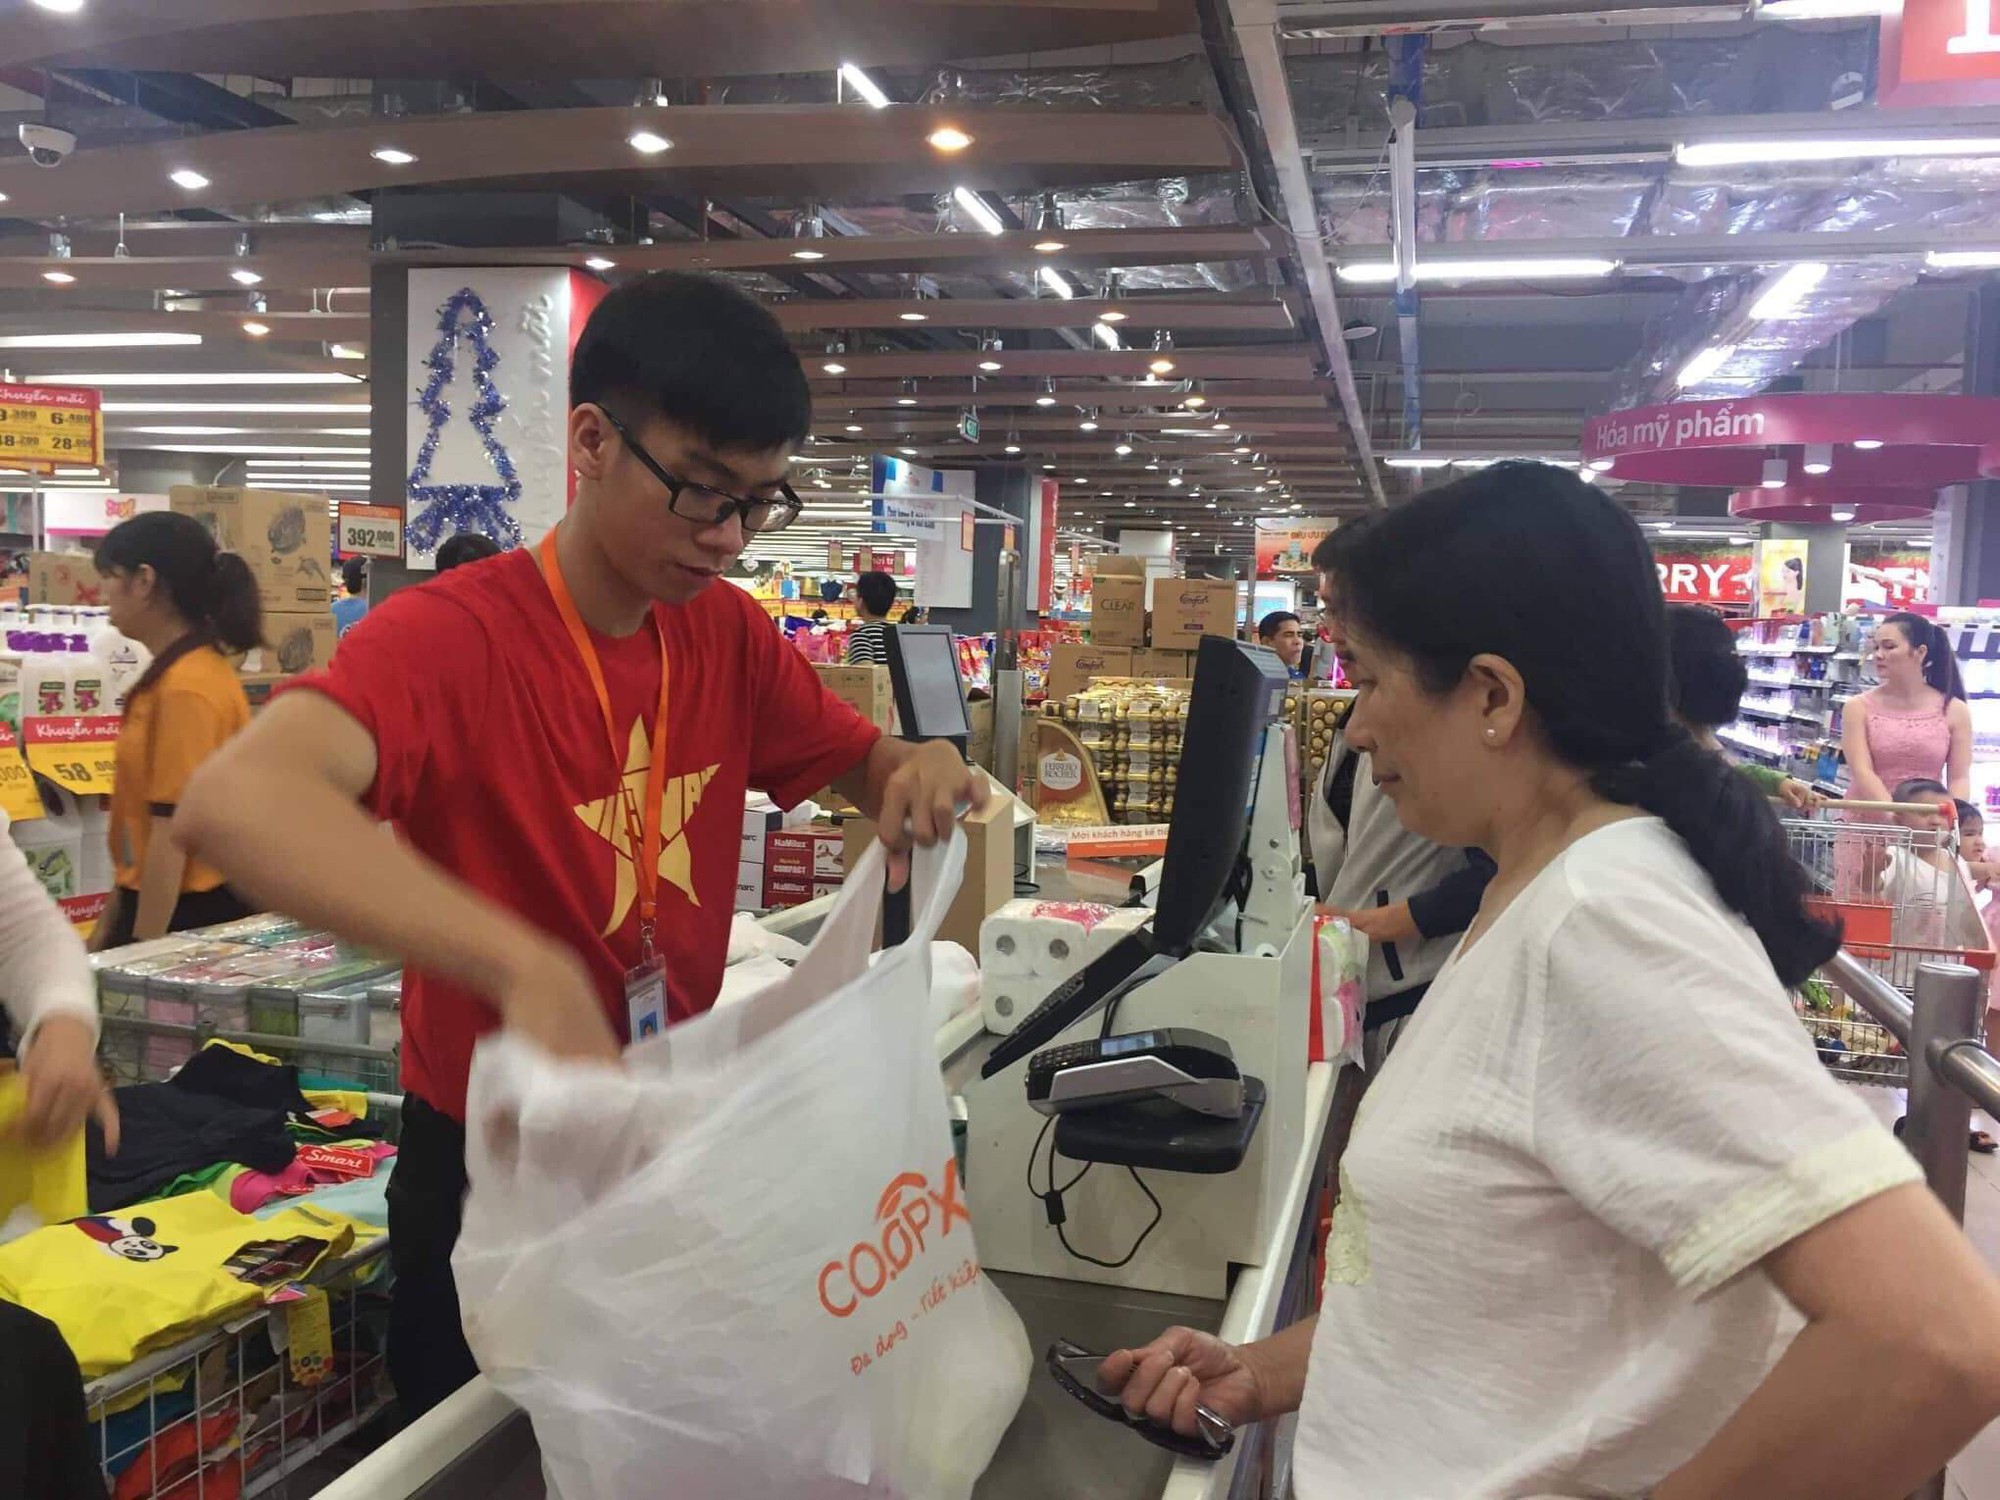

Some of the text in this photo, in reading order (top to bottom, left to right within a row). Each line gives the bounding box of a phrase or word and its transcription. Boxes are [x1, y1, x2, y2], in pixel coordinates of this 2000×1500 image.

[1597, 402, 1765, 450] Hóa mỹ phẩm
[1101, 598, 1136, 612] CLEAR
[306, 1149, 362, 1169] Smart
